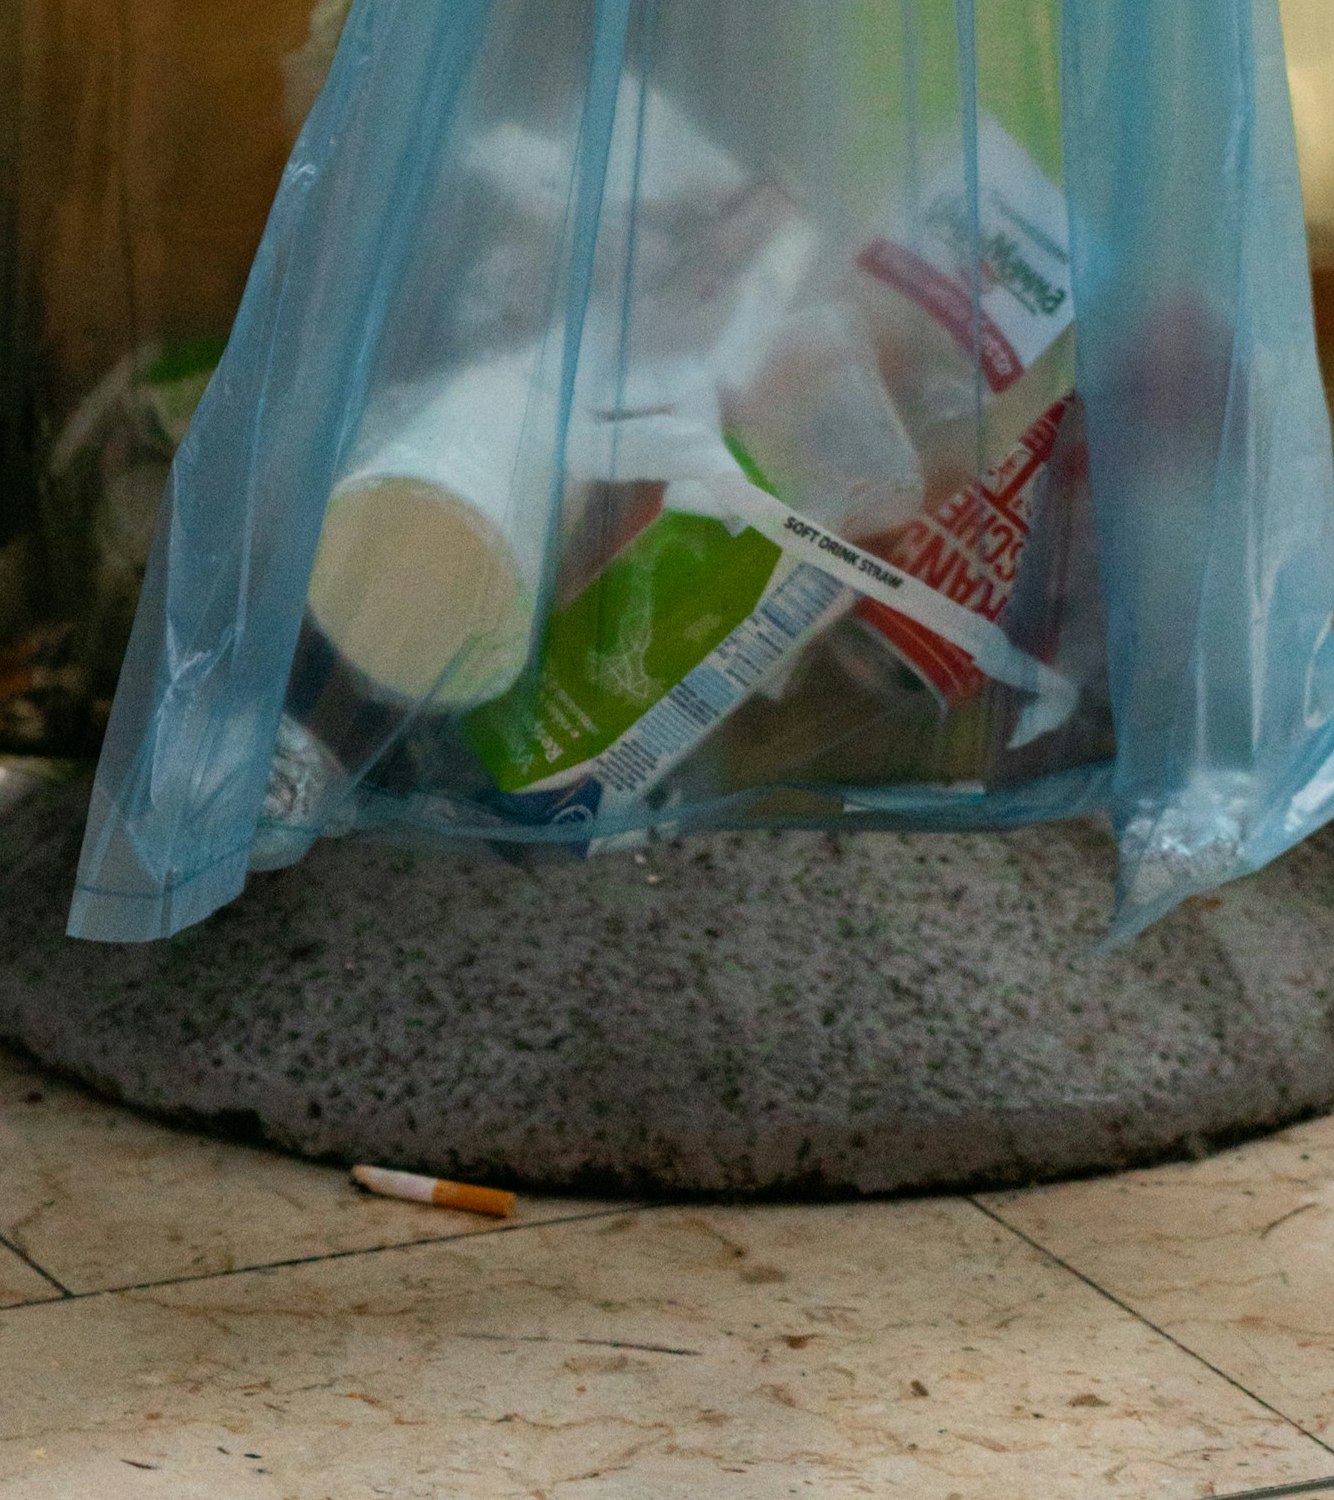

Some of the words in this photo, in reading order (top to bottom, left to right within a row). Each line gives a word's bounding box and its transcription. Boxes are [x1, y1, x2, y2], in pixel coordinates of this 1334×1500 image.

[783, 516, 819, 542] SOFT
[818, 536, 860, 566] DRINK
[858, 559, 903, 589] STRAW
